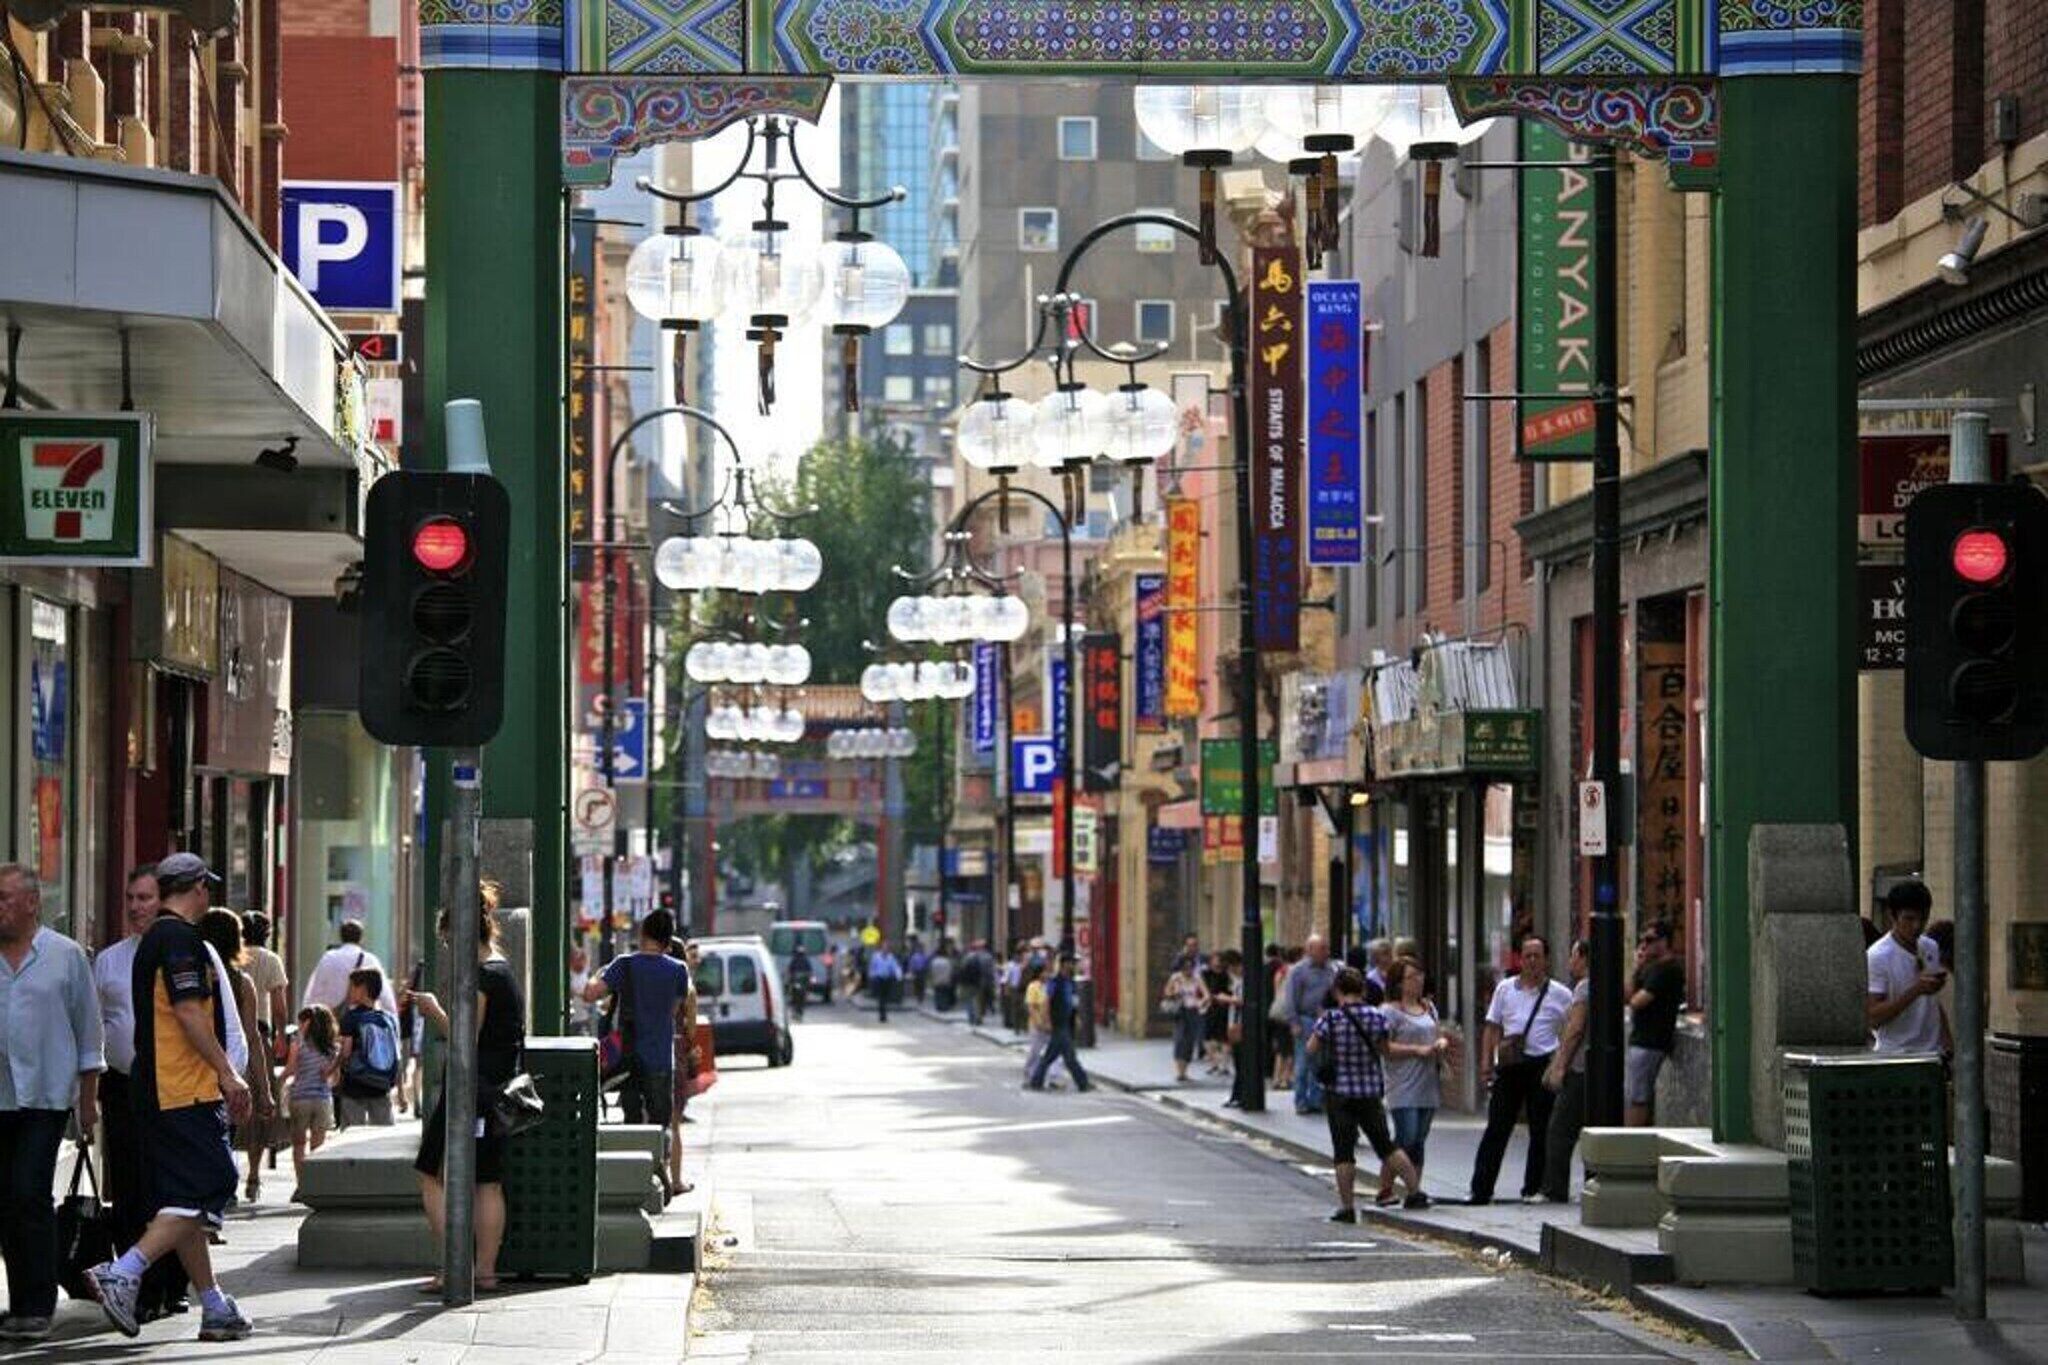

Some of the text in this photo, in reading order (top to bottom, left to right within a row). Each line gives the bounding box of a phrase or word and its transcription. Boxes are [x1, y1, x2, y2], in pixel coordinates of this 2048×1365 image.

[298, 203, 369, 292] P
[1269, 388, 1284, 439] STRAITS
[1269, 446, 1284, 462] OF
[1269, 468, 1285, 530] MALACCA
[1646, 664, 1687, 784] 百合屋
[1023, 744, 1056, 788] P
